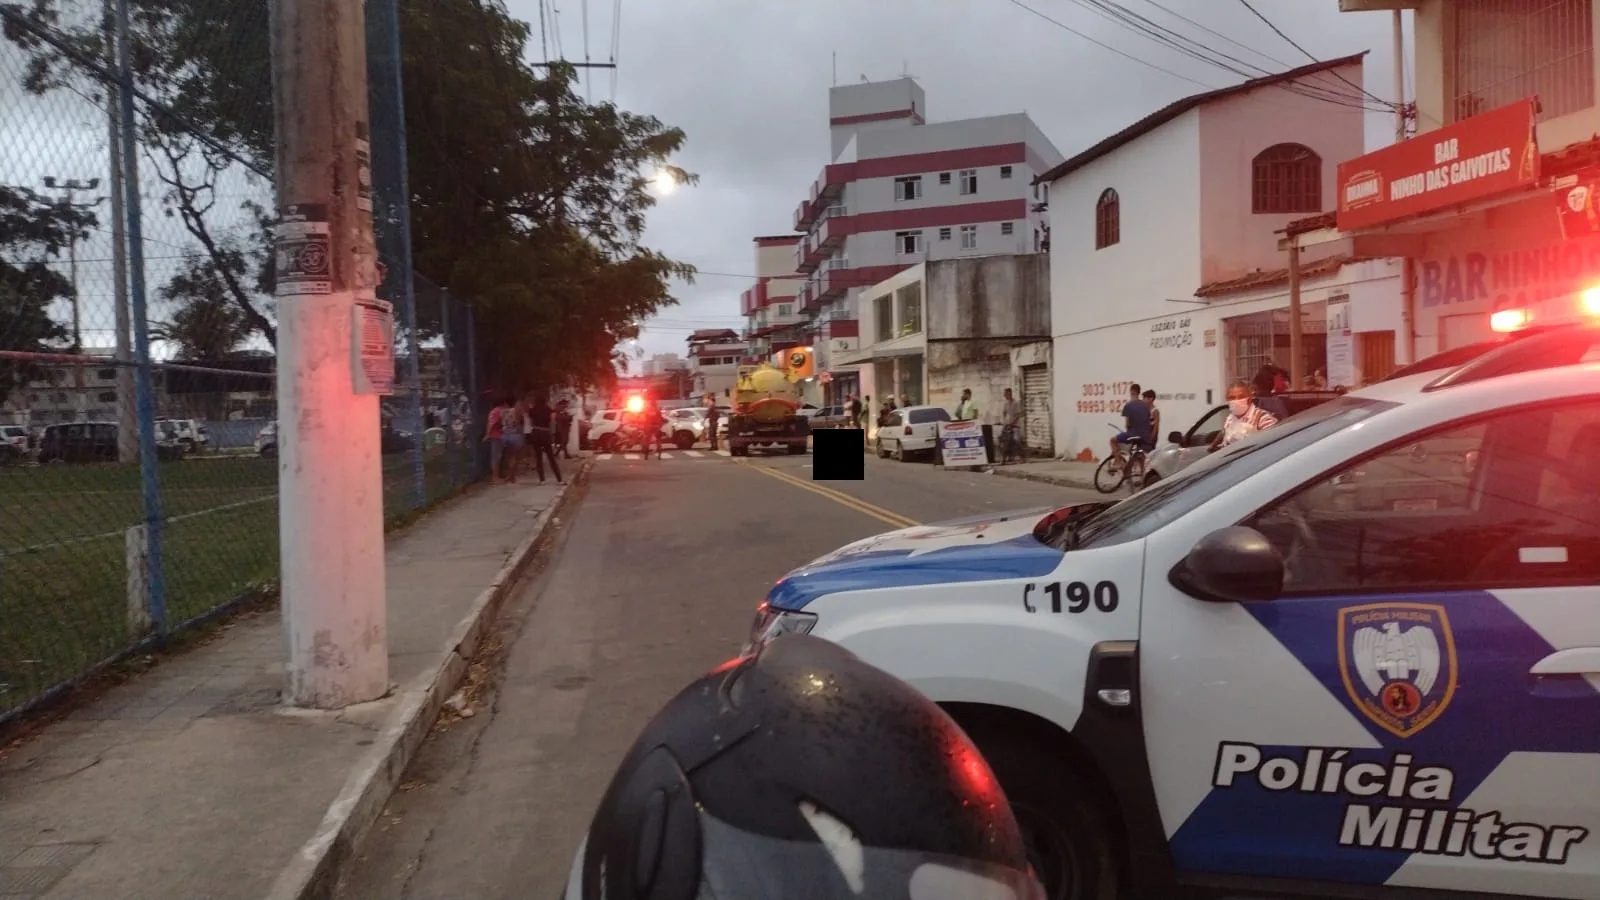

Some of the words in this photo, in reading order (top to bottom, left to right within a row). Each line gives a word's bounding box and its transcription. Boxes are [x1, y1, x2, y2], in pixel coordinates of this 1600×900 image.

[1390, 172, 1425, 202] NINHO
[1426, 165, 1449, 192] DAS
[1450, 147, 1512, 185] GAIVOTAS
[1434, 138, 1459, 166] BAR
[1422, 251, 1489, 308] BAR
[1492, 242, 1582, 290] NINHO
[1043, 581, 1119, 613] 190
[1213, 741, 1455, 801] Polícia
[1339, 804, 1588, 864] Militar
